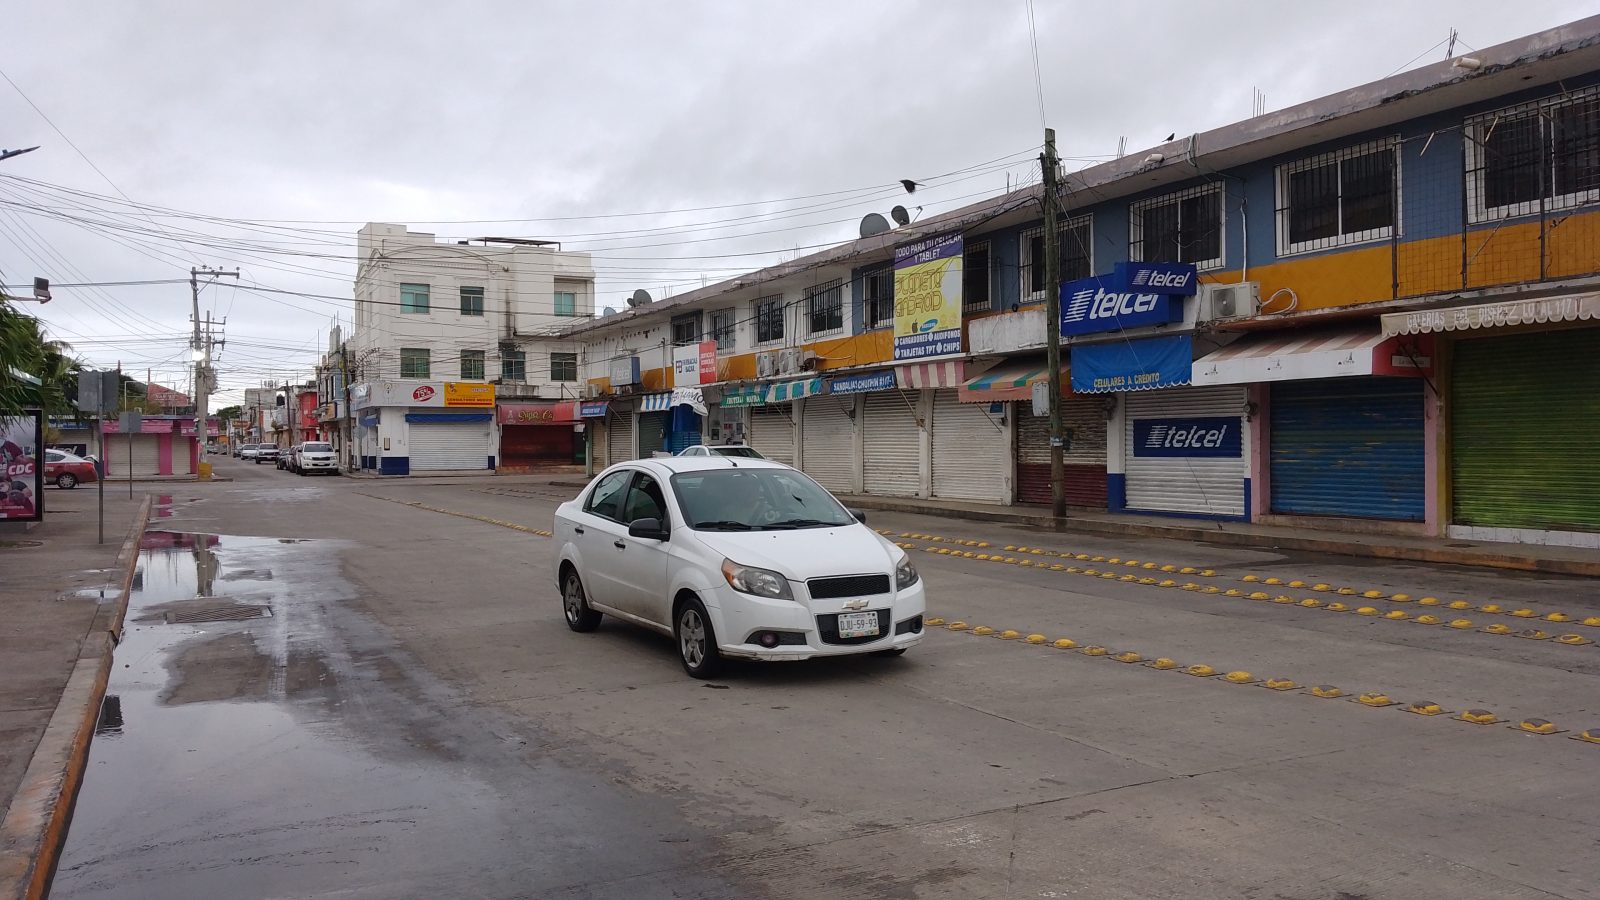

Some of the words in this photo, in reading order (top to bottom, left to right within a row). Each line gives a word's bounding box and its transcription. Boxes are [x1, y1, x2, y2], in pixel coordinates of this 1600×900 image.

[911, 241, 926, 254] PARA
[919, 248, 941, 262] TABLET
[1147, 270, 1191, 287] telcel
[900, 332, 929, 346] CARGADORES
[934, 329, 961, 341] AUDIFONOS
[901, 346, 925, 358] TARJETAS
[926, 344, 936, 355] TPT
[943, 341, 960, 352] CHIPS
[1093, 376, 1125, 388] CELULARES
[1164, 424, 1227, 448] telcel
[8, 463, 33, 475] CDC
